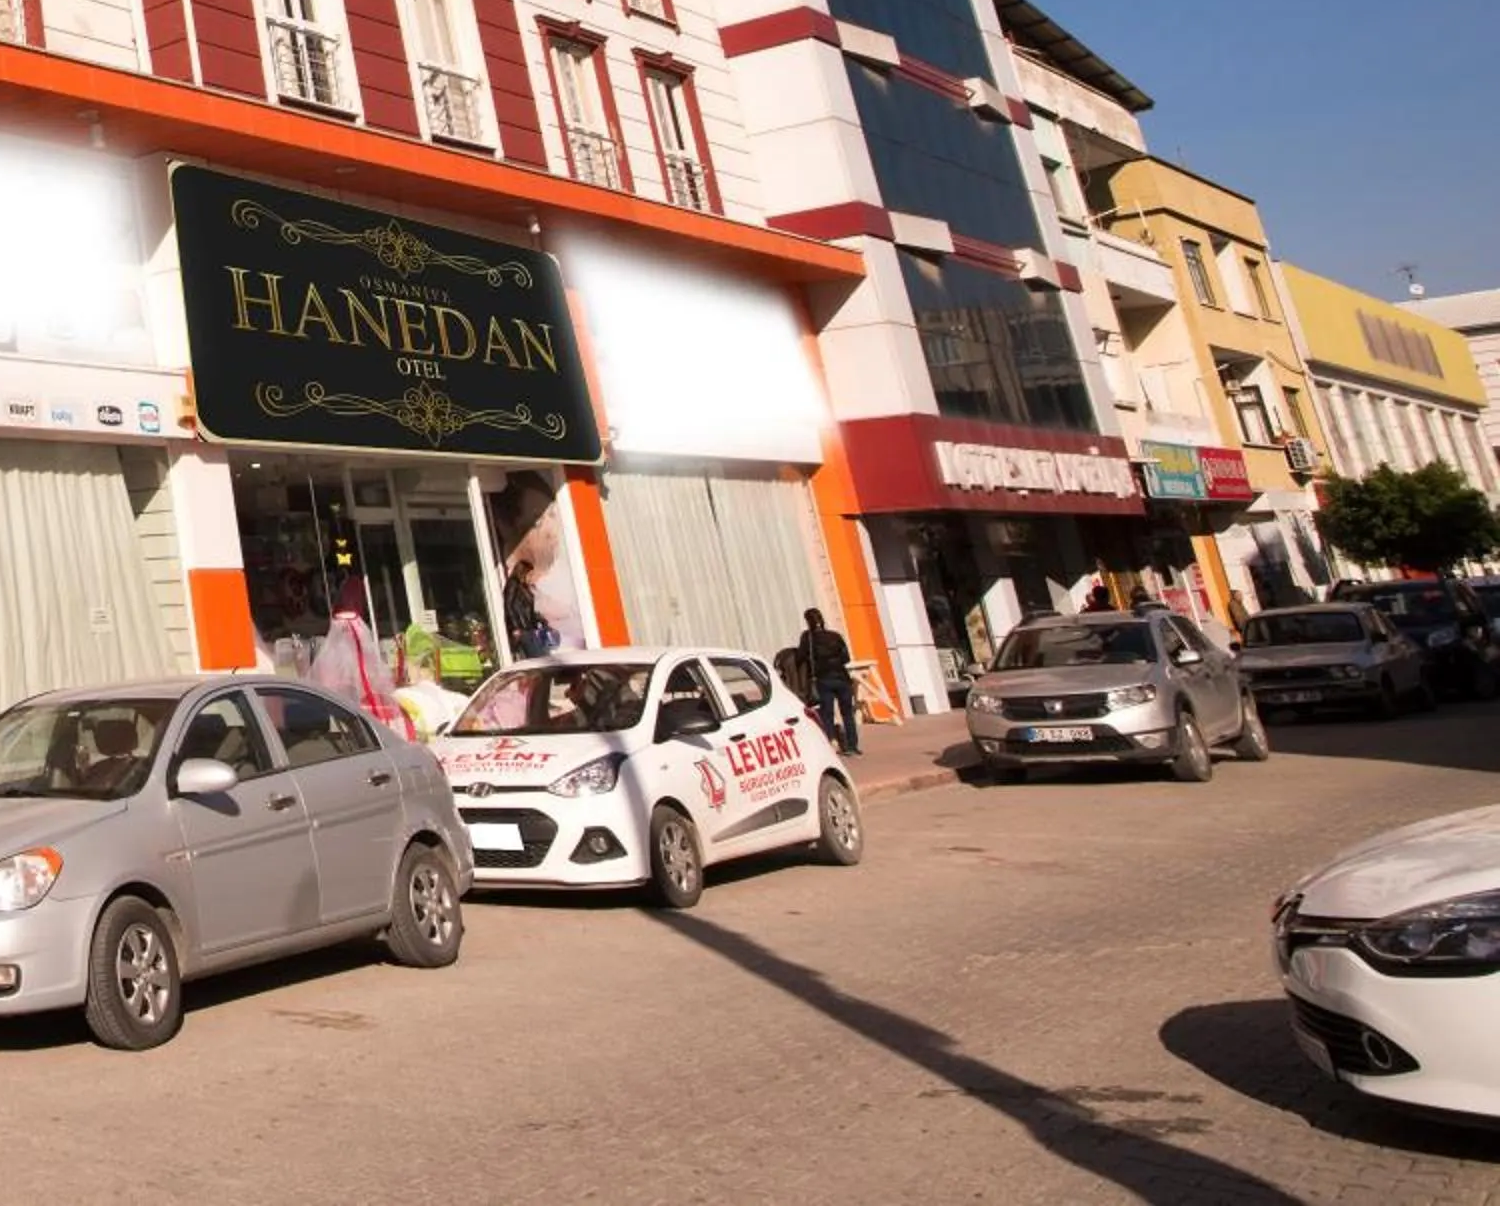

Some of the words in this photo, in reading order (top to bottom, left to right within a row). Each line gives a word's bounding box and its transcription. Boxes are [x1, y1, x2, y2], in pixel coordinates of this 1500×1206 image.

[223, 264, 560, 374] HANEDAN
[396, 357, 447, 381] OTEL
[725, 728, 801, 776] LEVENT
